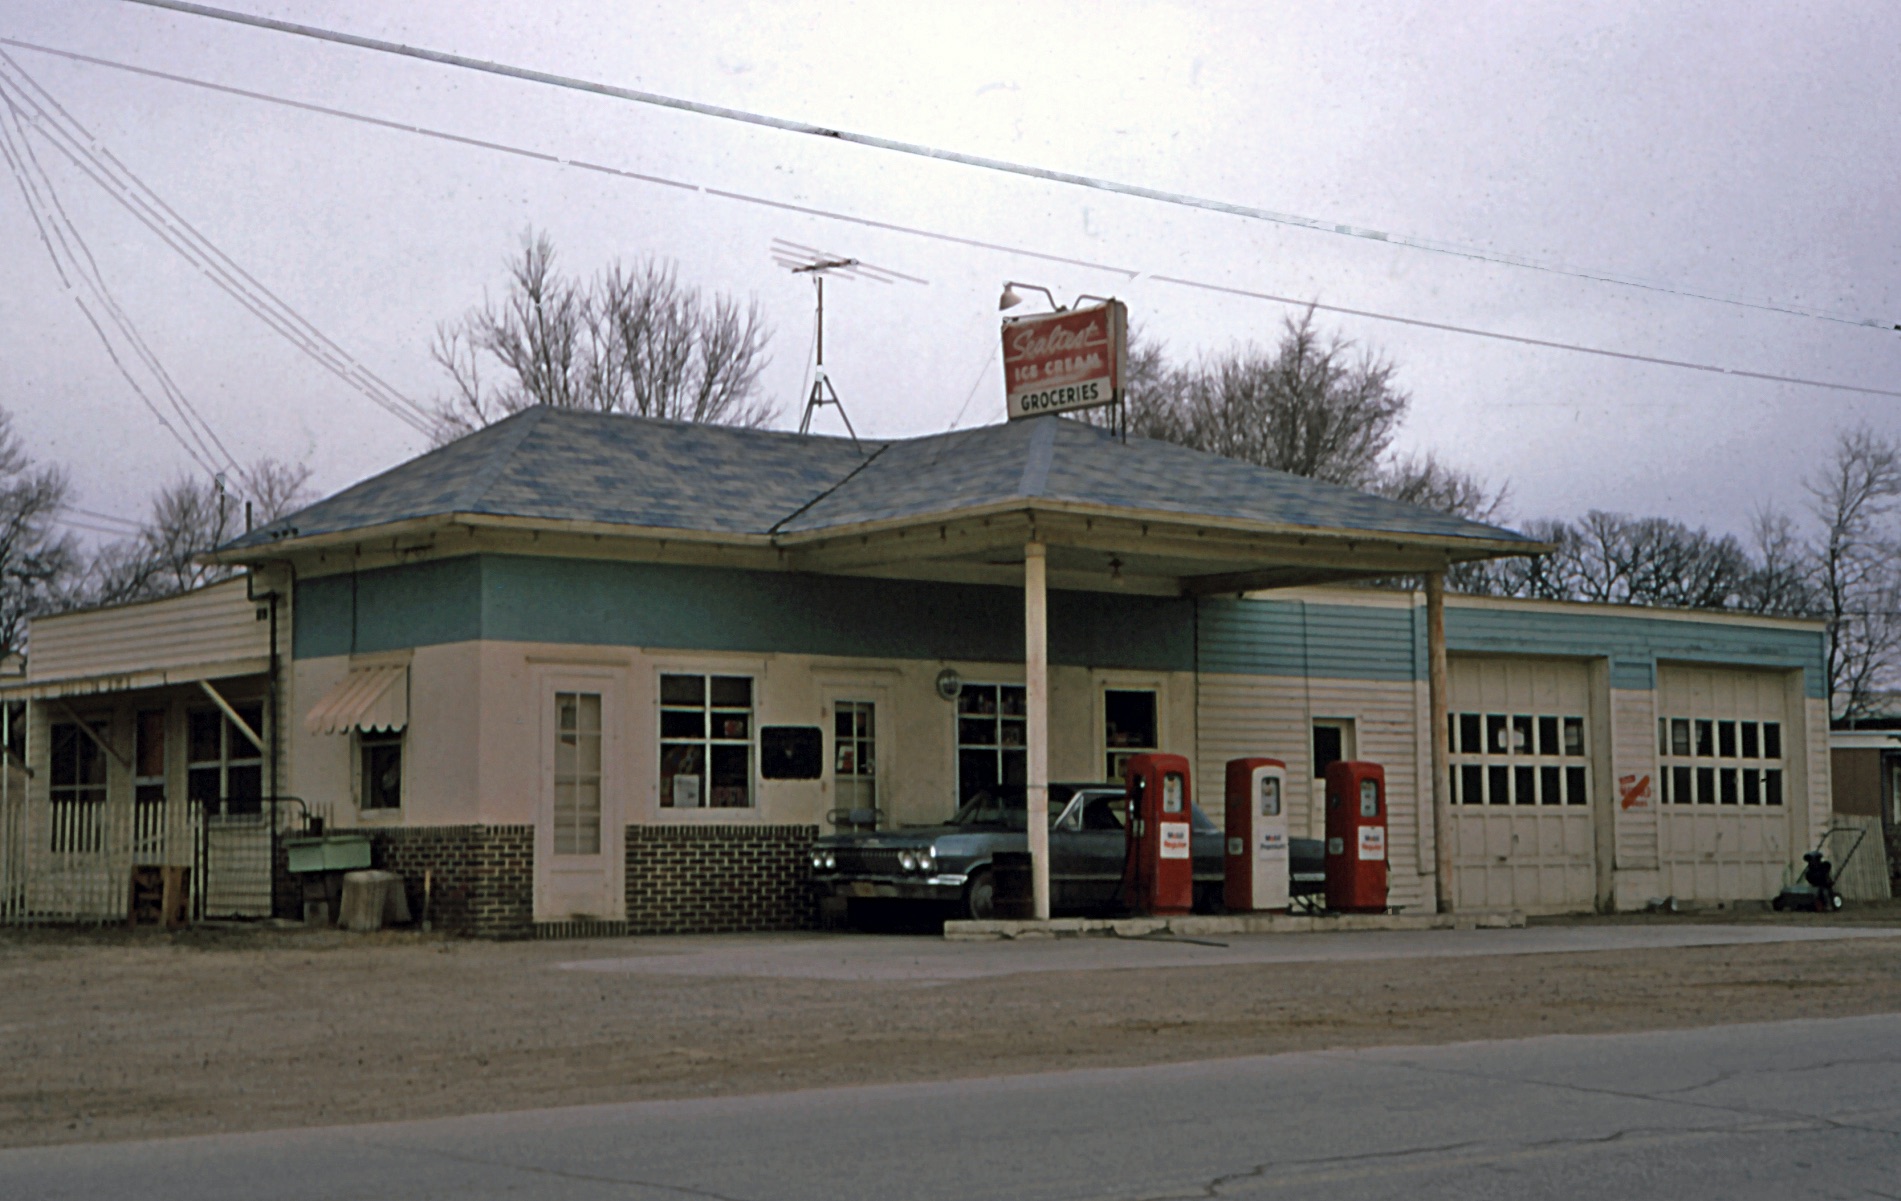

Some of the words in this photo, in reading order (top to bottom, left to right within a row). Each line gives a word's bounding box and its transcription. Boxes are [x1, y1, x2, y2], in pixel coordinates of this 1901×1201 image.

[1014, 364, 1038, 382] ICE
[1045, 353, 1102, 375] CREAM
[1021, 382, 1098, 411] GROCERIES
